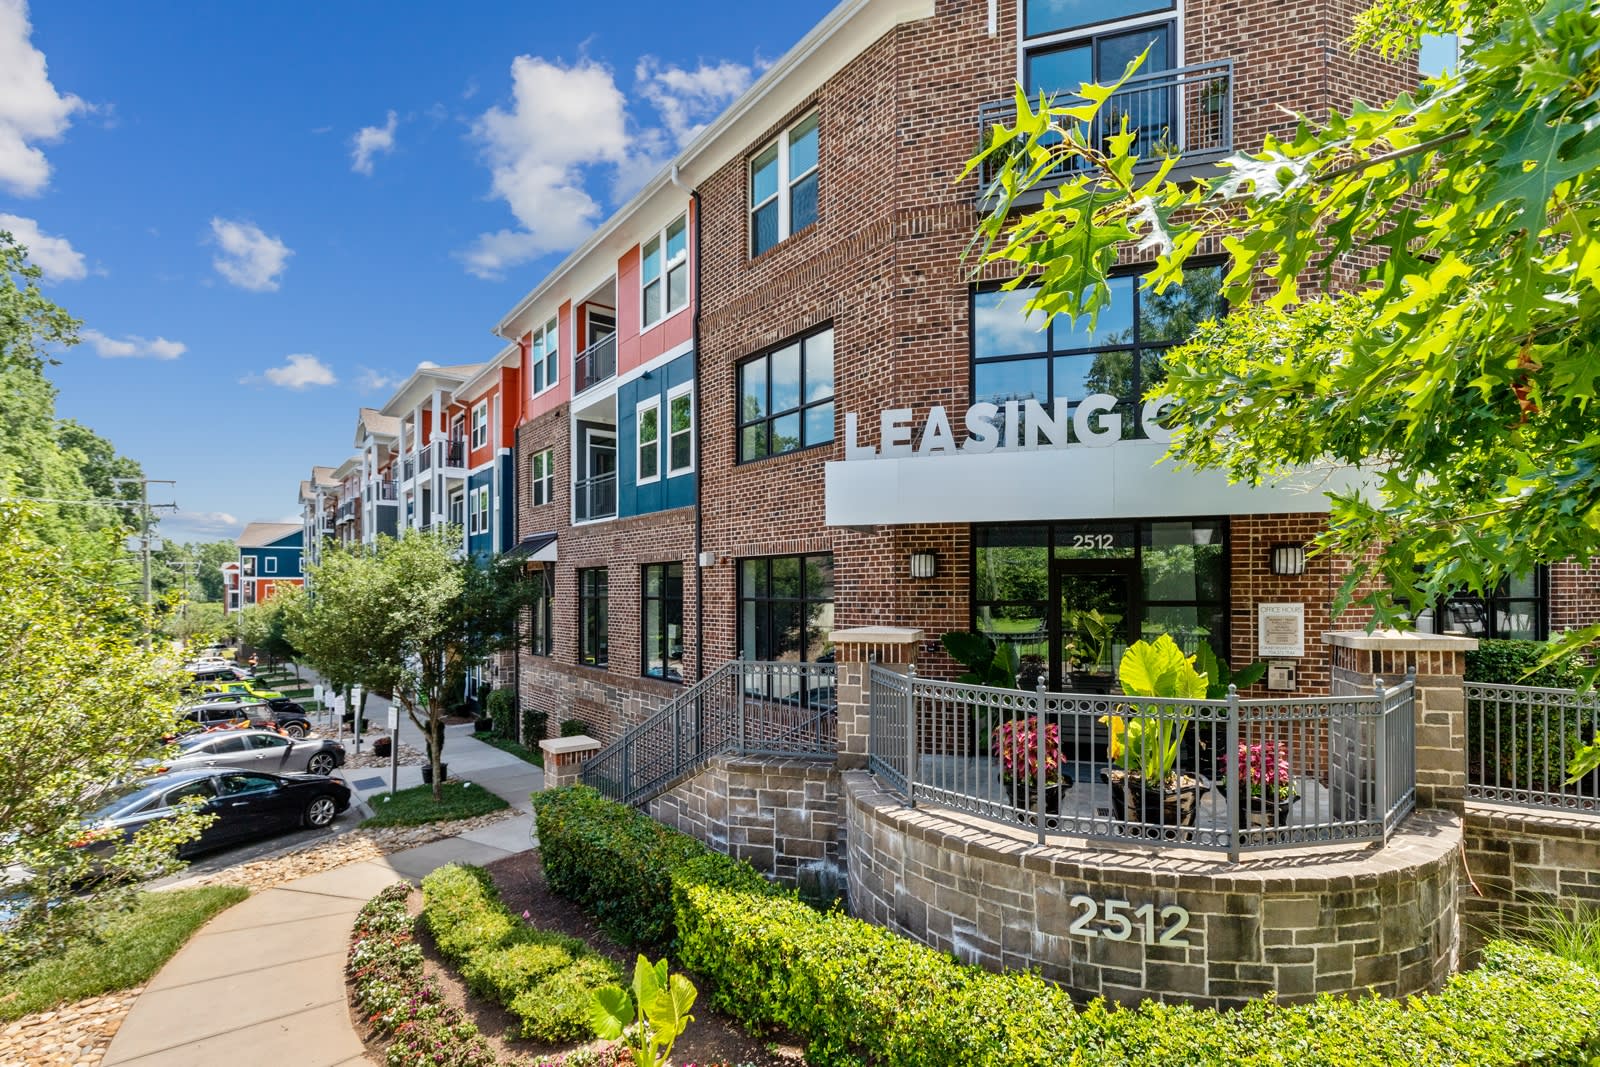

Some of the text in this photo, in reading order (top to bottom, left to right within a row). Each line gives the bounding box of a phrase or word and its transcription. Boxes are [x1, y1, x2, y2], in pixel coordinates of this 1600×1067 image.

[845, 394, 1121, 462] LEASING
[1073, 534, 1114, 550] 2512
[1069, 895, 1190, 947] 2512
